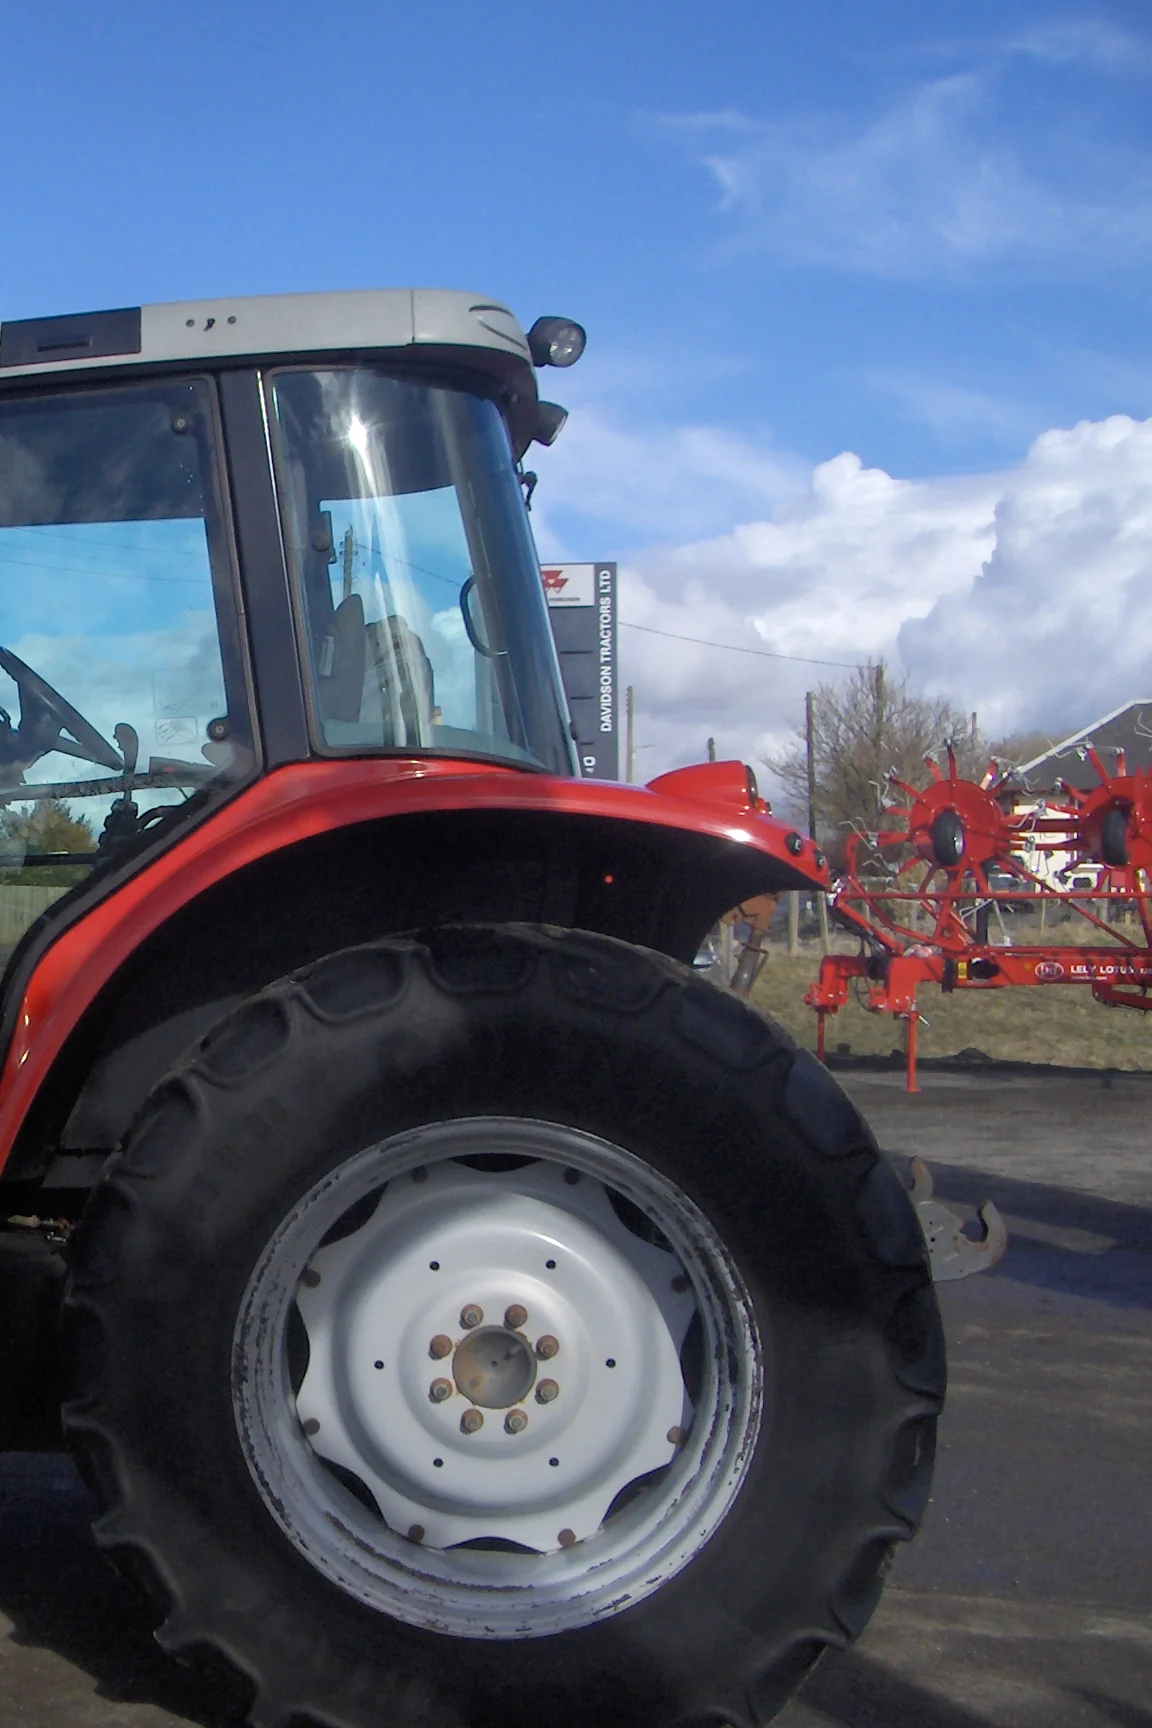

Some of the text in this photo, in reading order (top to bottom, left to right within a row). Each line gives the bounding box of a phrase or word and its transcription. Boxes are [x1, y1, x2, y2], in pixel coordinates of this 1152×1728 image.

[599, 569, 613, 732] DAVIDSON TRACTORS LTD
